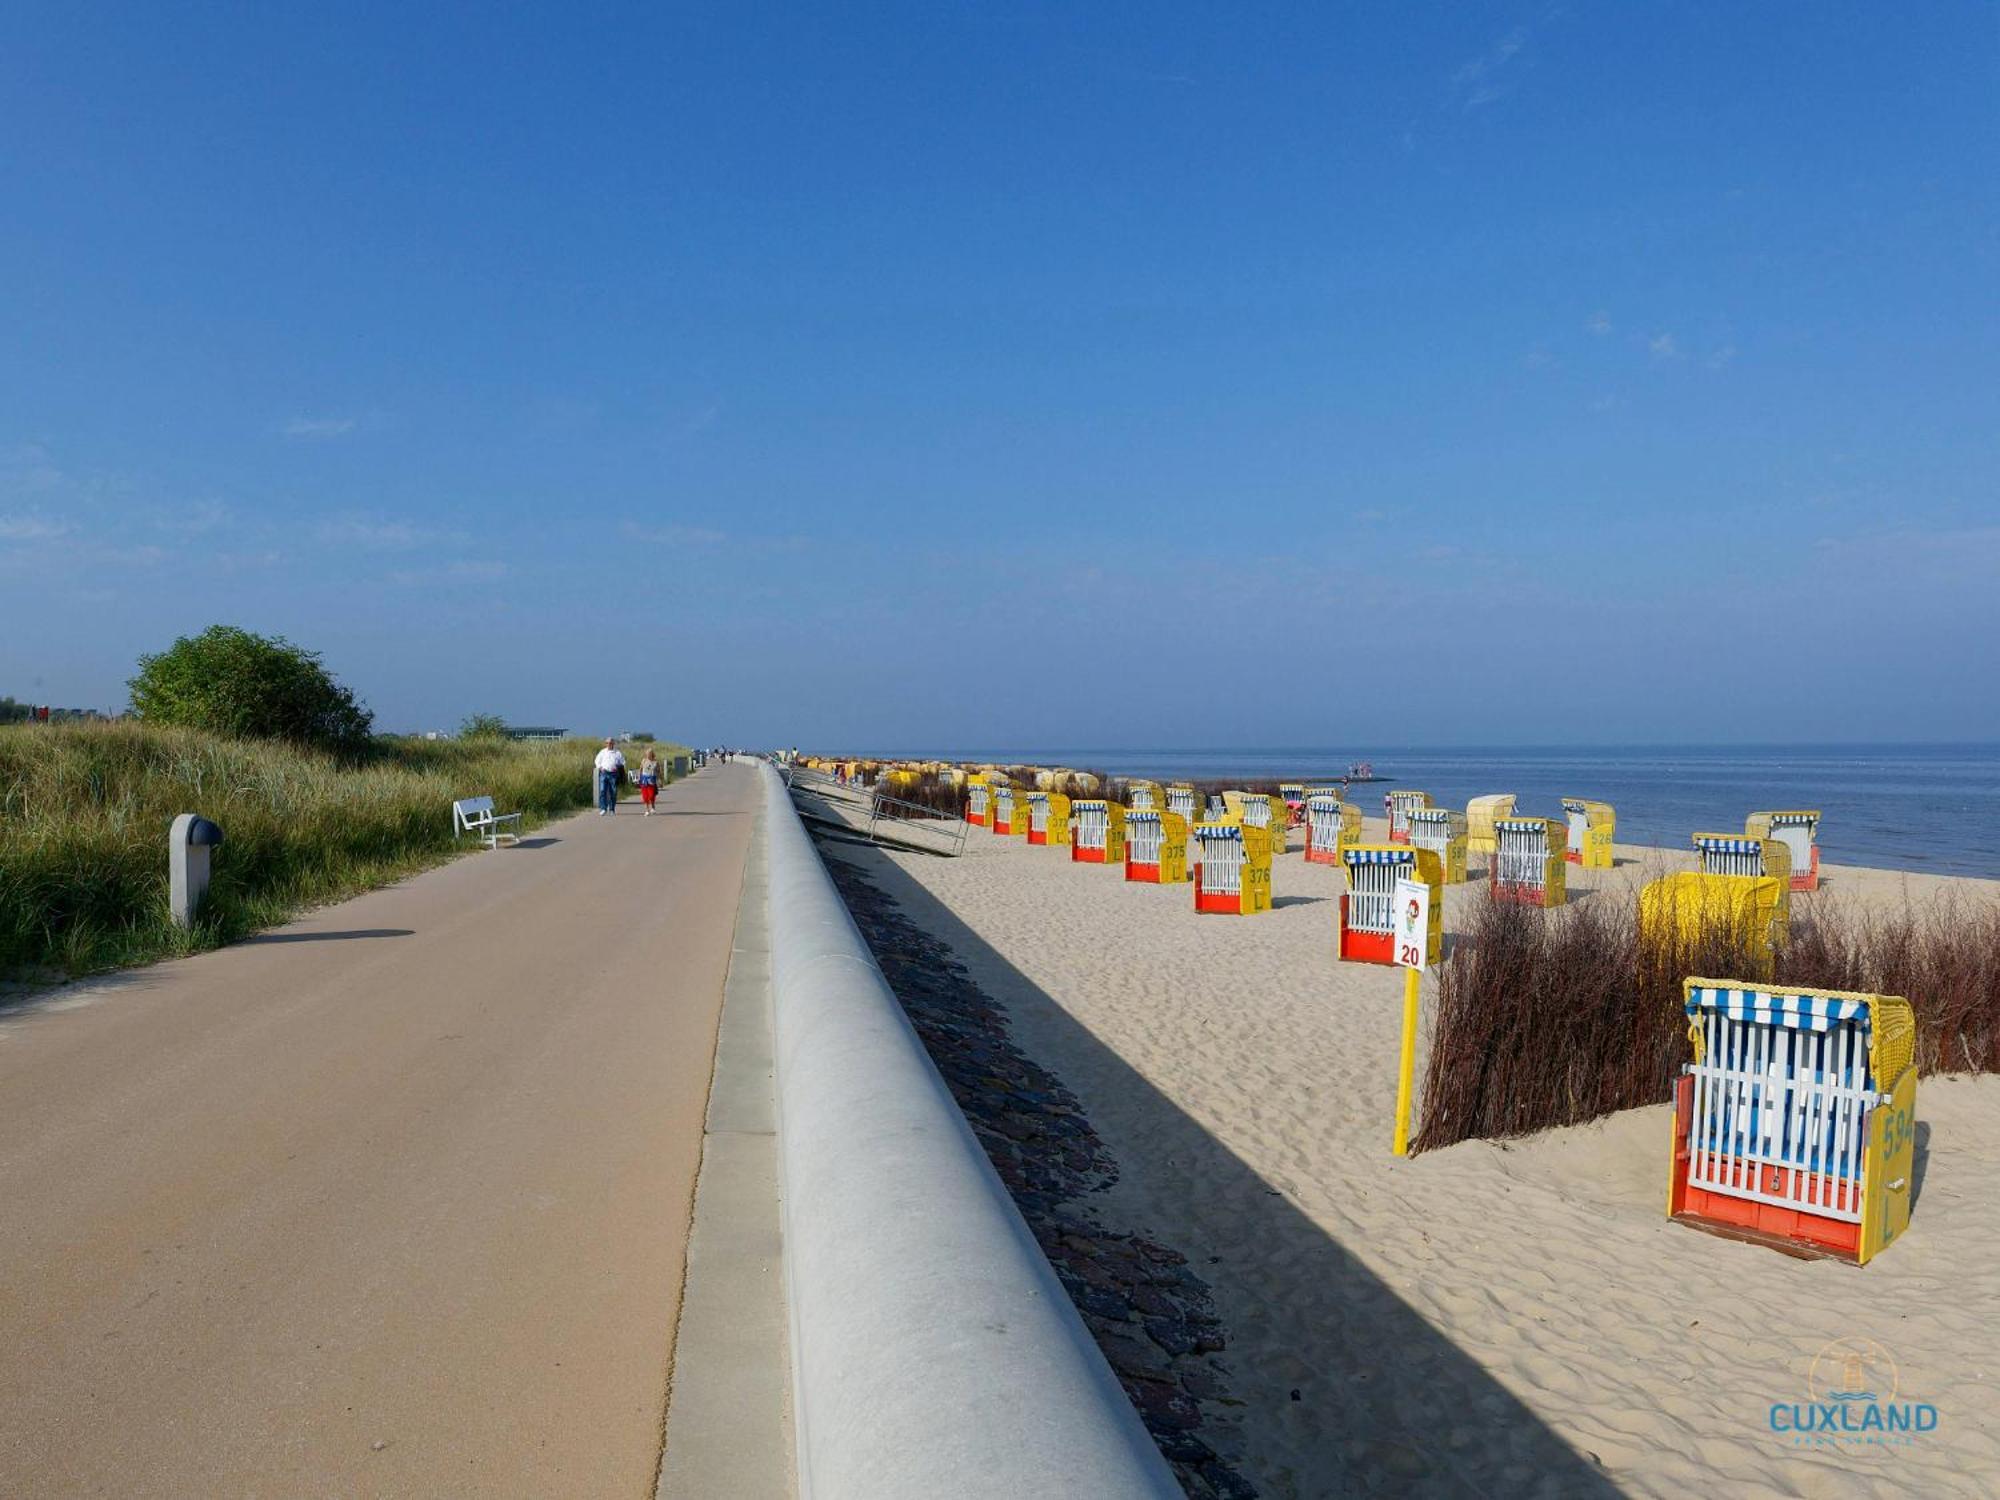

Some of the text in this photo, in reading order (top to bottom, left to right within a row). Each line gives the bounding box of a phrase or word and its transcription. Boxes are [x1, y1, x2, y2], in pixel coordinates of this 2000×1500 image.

[1166, 845, 1186, 859] 375
[1250, 867, 1271, 884] 376
[1401, 944, 1420, 966] 20
[1882, 1101, 1916, 1162] 594
